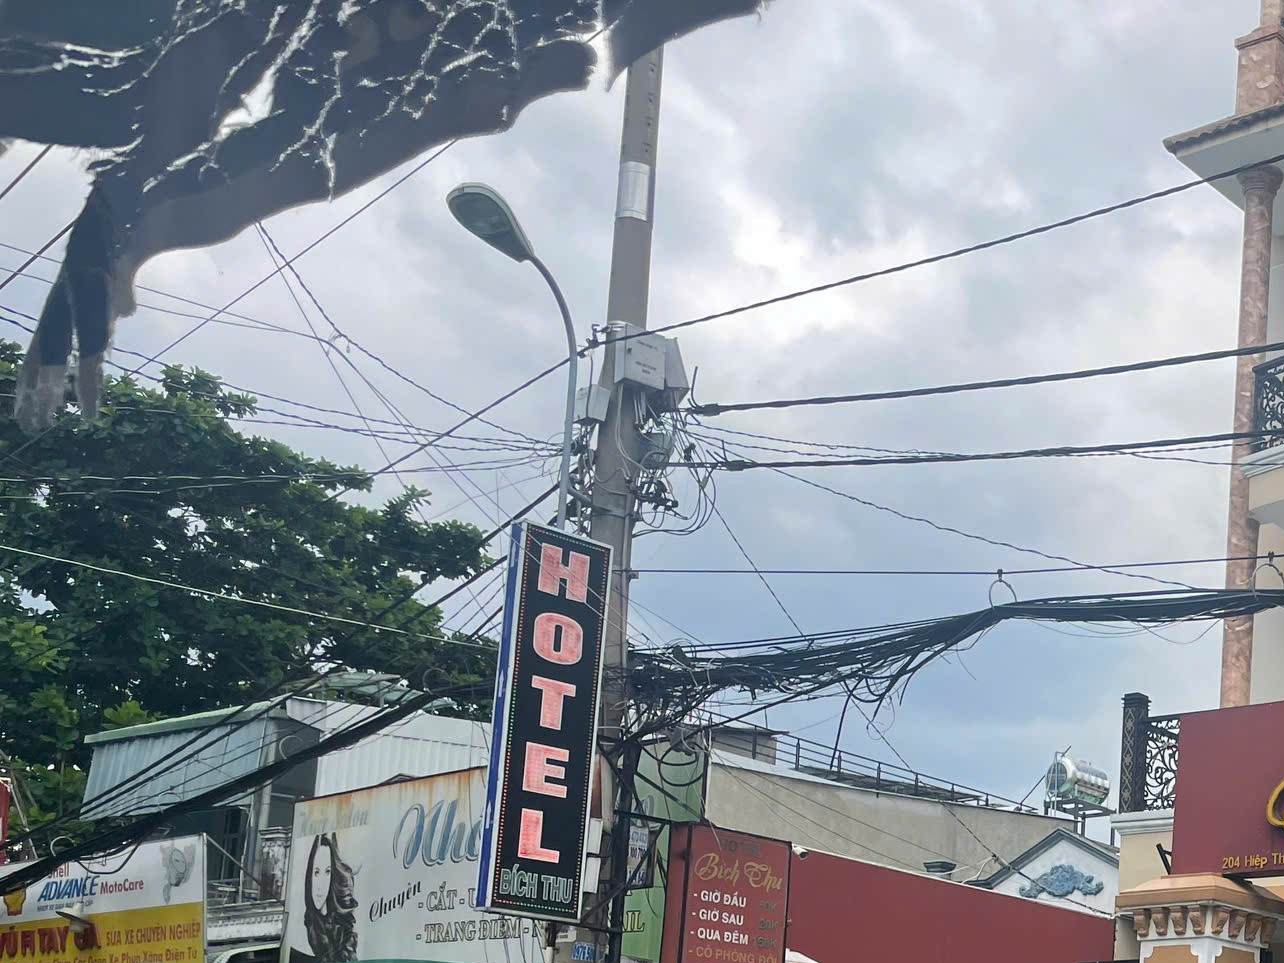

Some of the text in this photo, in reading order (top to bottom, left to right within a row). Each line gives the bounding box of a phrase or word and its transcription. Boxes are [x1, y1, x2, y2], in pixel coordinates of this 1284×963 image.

[517, 541, 592, 864] HOTEL
[1222, 856, 1241, 870] 204
[1244, 853, 1268, 871] Hiệp
[38, 877, 144, 901] ADVANCE MotoCare
[499, 862, 573, 905] BÍCH THU
[700, 889, 720, 904] GIỜ
[699, 908, 719, 922] GIỜ
[721, 912, 744, 926] SAU
[38, 926, 70, 954] TAY
[125, 928, 134, 945] XE
[424, 920, 476, 943] TRANG
[697, 928, 749, 945] QUA ĐÊM
